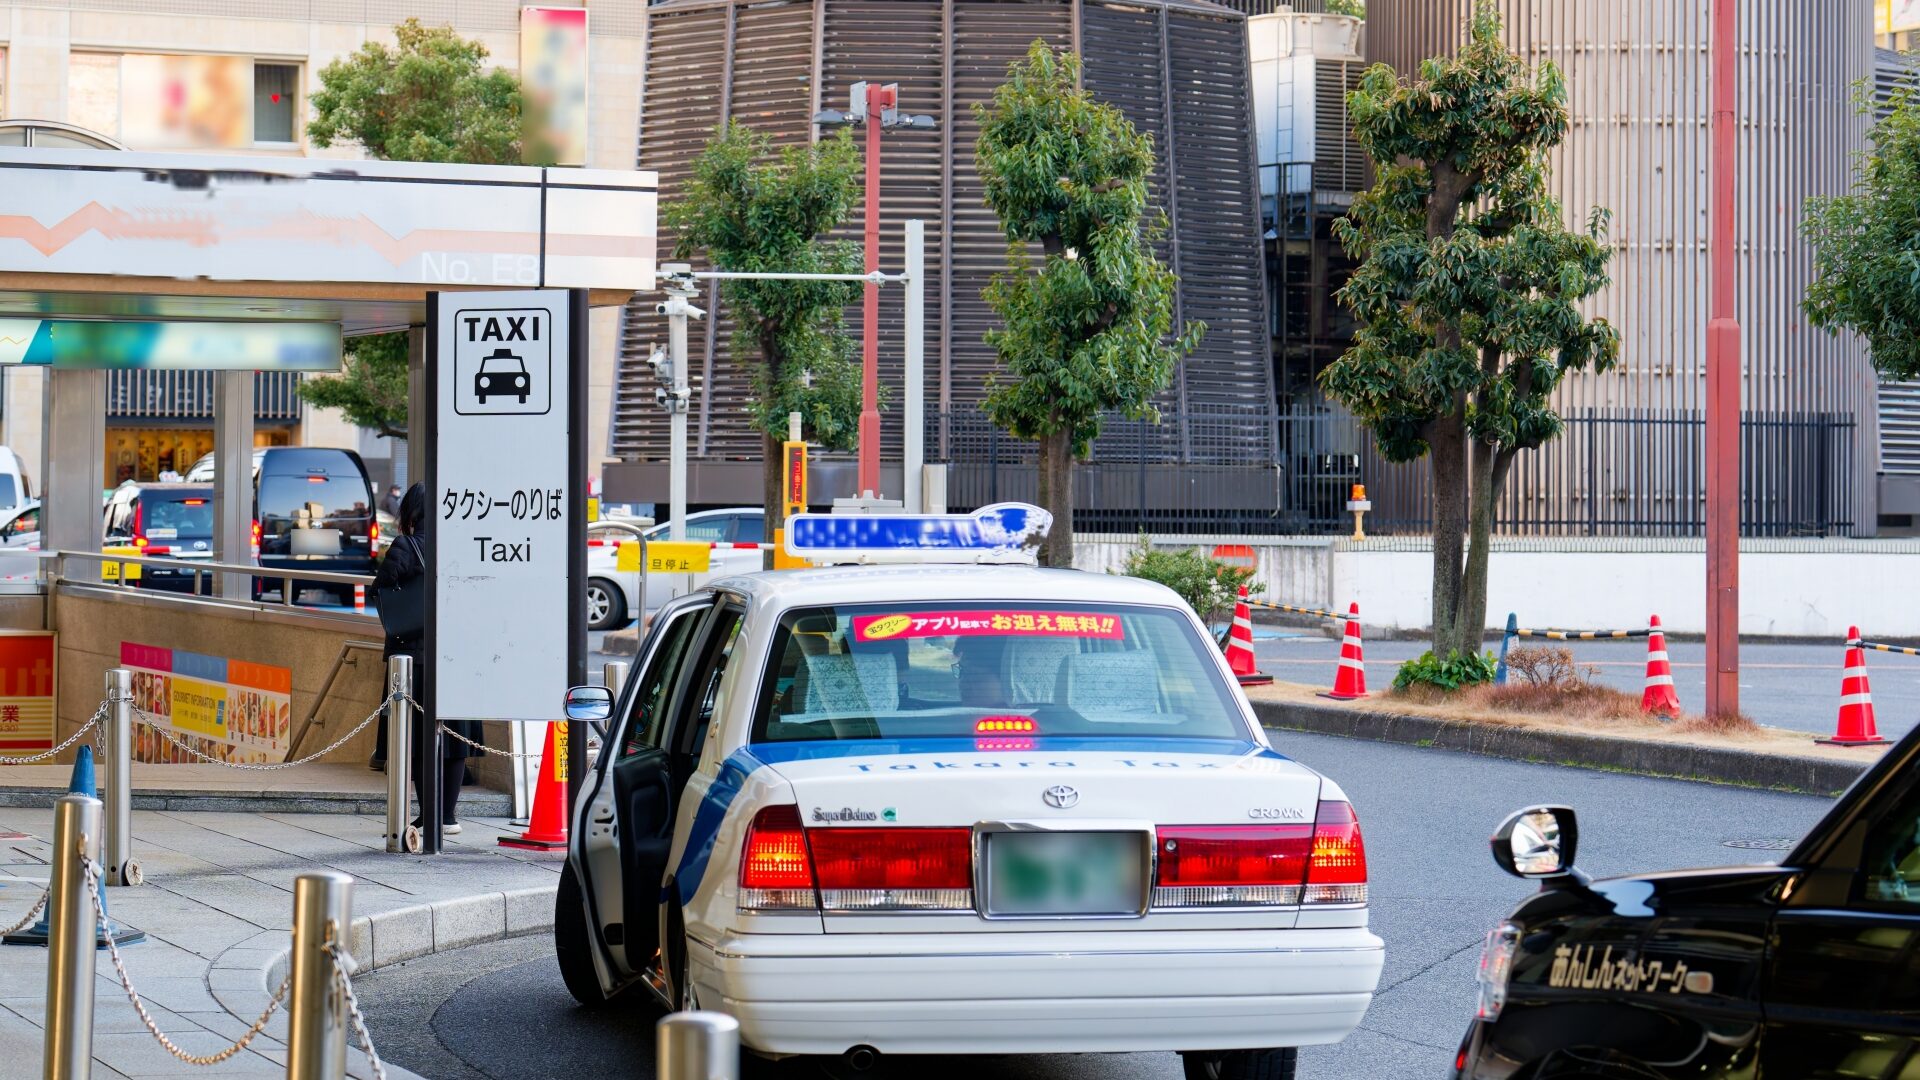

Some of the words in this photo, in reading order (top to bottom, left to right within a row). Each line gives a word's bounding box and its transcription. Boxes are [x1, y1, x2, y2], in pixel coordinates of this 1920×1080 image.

[421, 252, 477, 283] No.
[492, 253, 540, 284] E8
[464, 316, 539, 342] TAXI
[442, 488, 563, 520] タクシーのりば
[473, 537, 531, 562] Taxi
[849, 761, 1076, 772] Takara
[1113, 759, 1240, 769] Tax
[1248, 807, 1305, 819] CROWN
[1549, 943, 1688, 994] あんしんネットワーク
